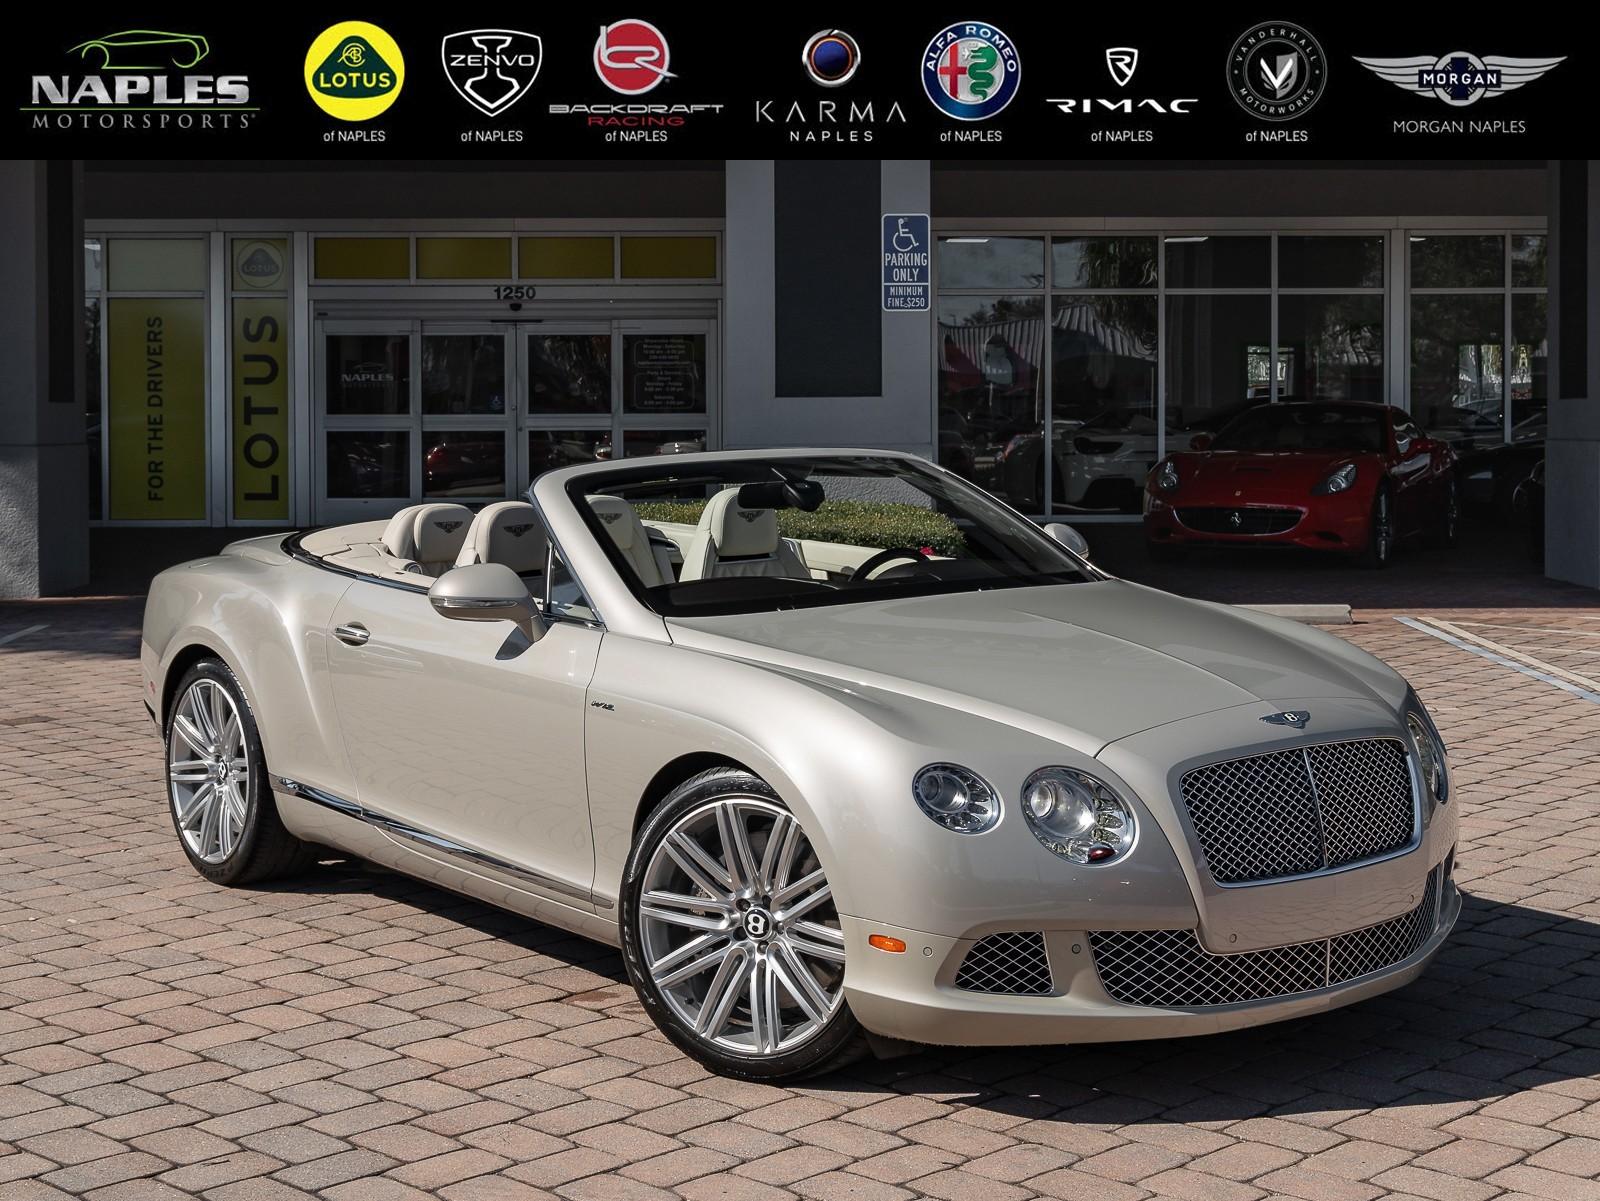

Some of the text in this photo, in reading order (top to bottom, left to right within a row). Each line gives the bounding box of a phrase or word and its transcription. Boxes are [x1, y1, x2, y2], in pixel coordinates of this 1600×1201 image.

[884, 252, 928, 266] PARKING
[893, 268, 919, 281] ONLY
[494, 285, 536, 300] 1250
[889, 286, 923, 296] MINIMUM
[887, 297, 925, 308] FINE $250
[146, 315, 164, 502] FOR THE DRIVERS
[243, 315, 280, 501] LOTUS
